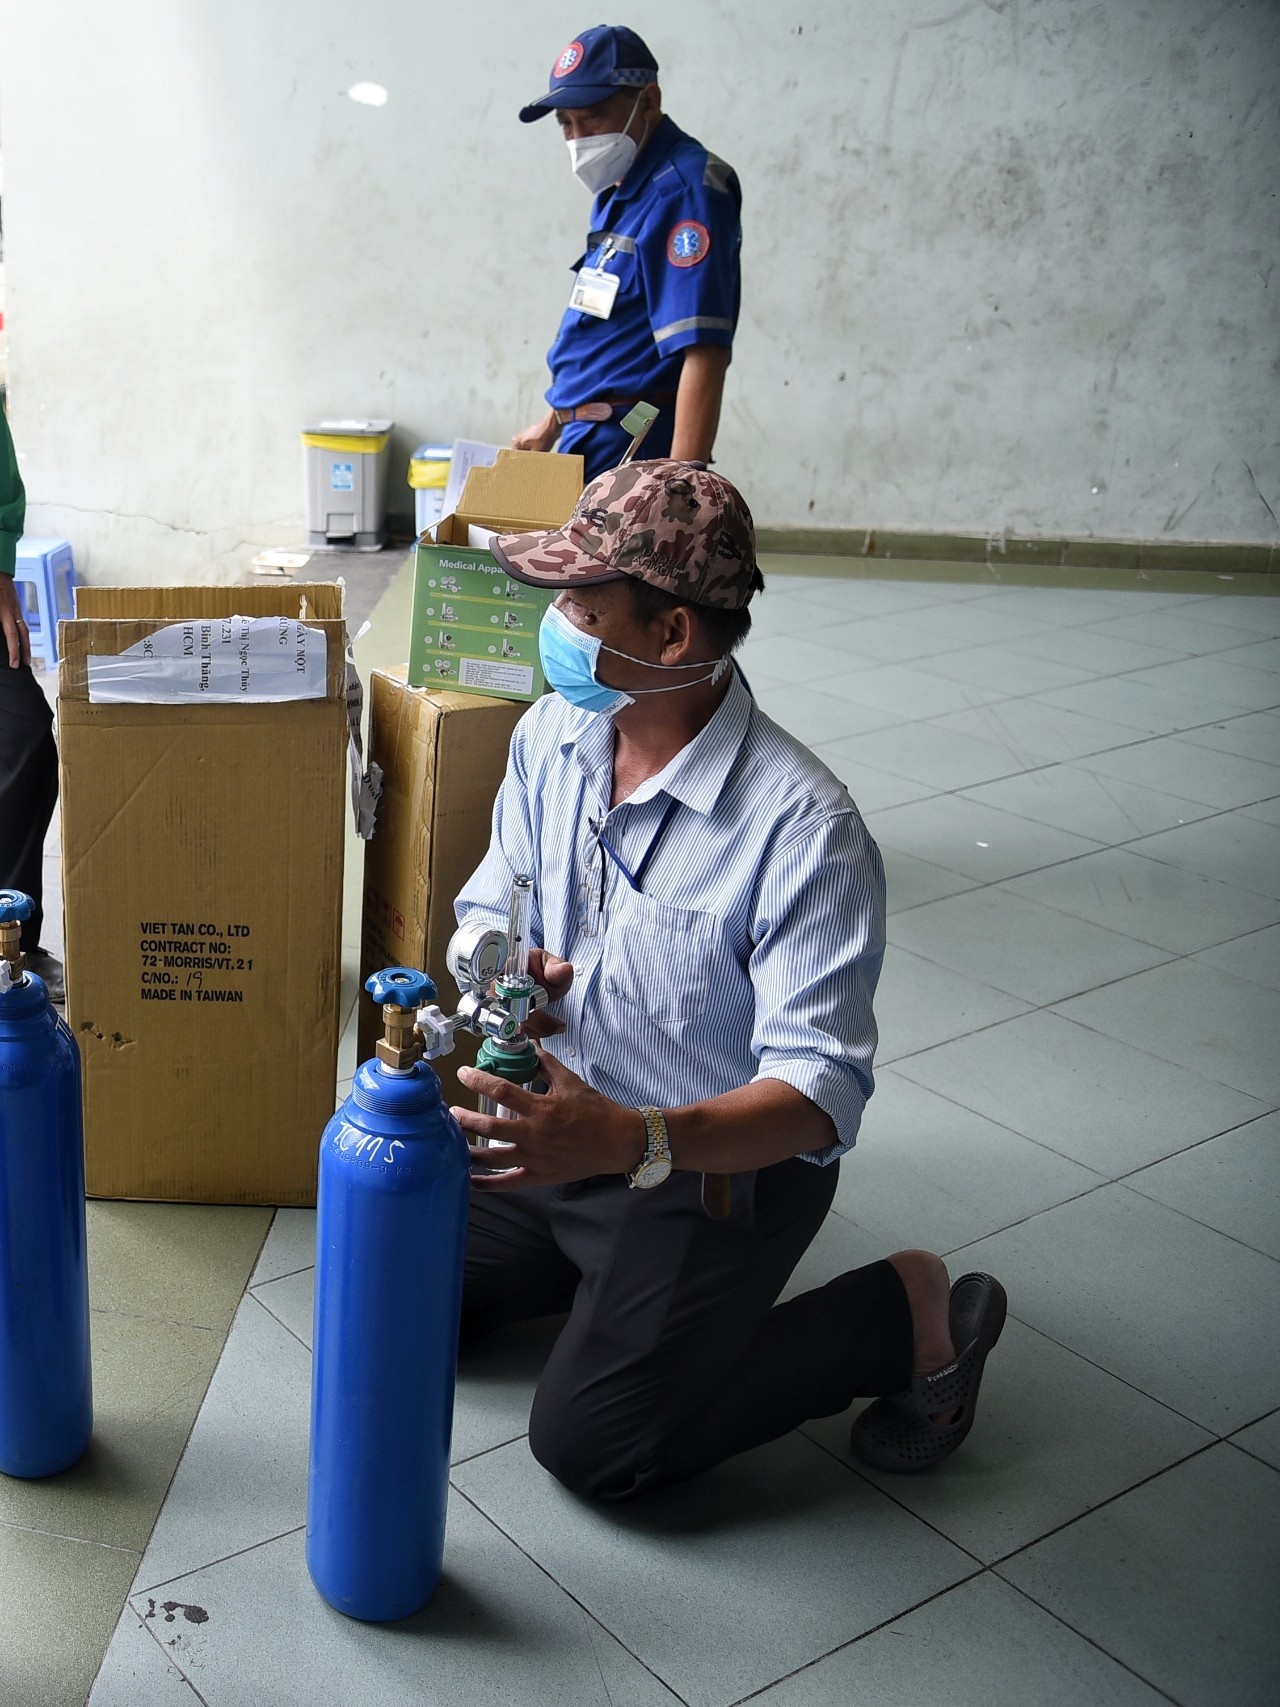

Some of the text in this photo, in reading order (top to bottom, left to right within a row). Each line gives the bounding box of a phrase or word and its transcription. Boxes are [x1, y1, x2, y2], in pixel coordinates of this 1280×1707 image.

[439, 559, 476, 571] Medical
[183, 626, 194, 656] HCM
[238, 627, 250, 641] Thị
[238, 643, 250, 667] Ngọc
[294, 649, 307, 674] MỘT
[140, 922, 250, 938] VIET TAN CO., LTD
[140, 940, 232, 954] CONTRACT NO:
[141, 972, 179, 985] C/NO.:
[141, 988, 243, 1002] MADE IN TAIWAN
